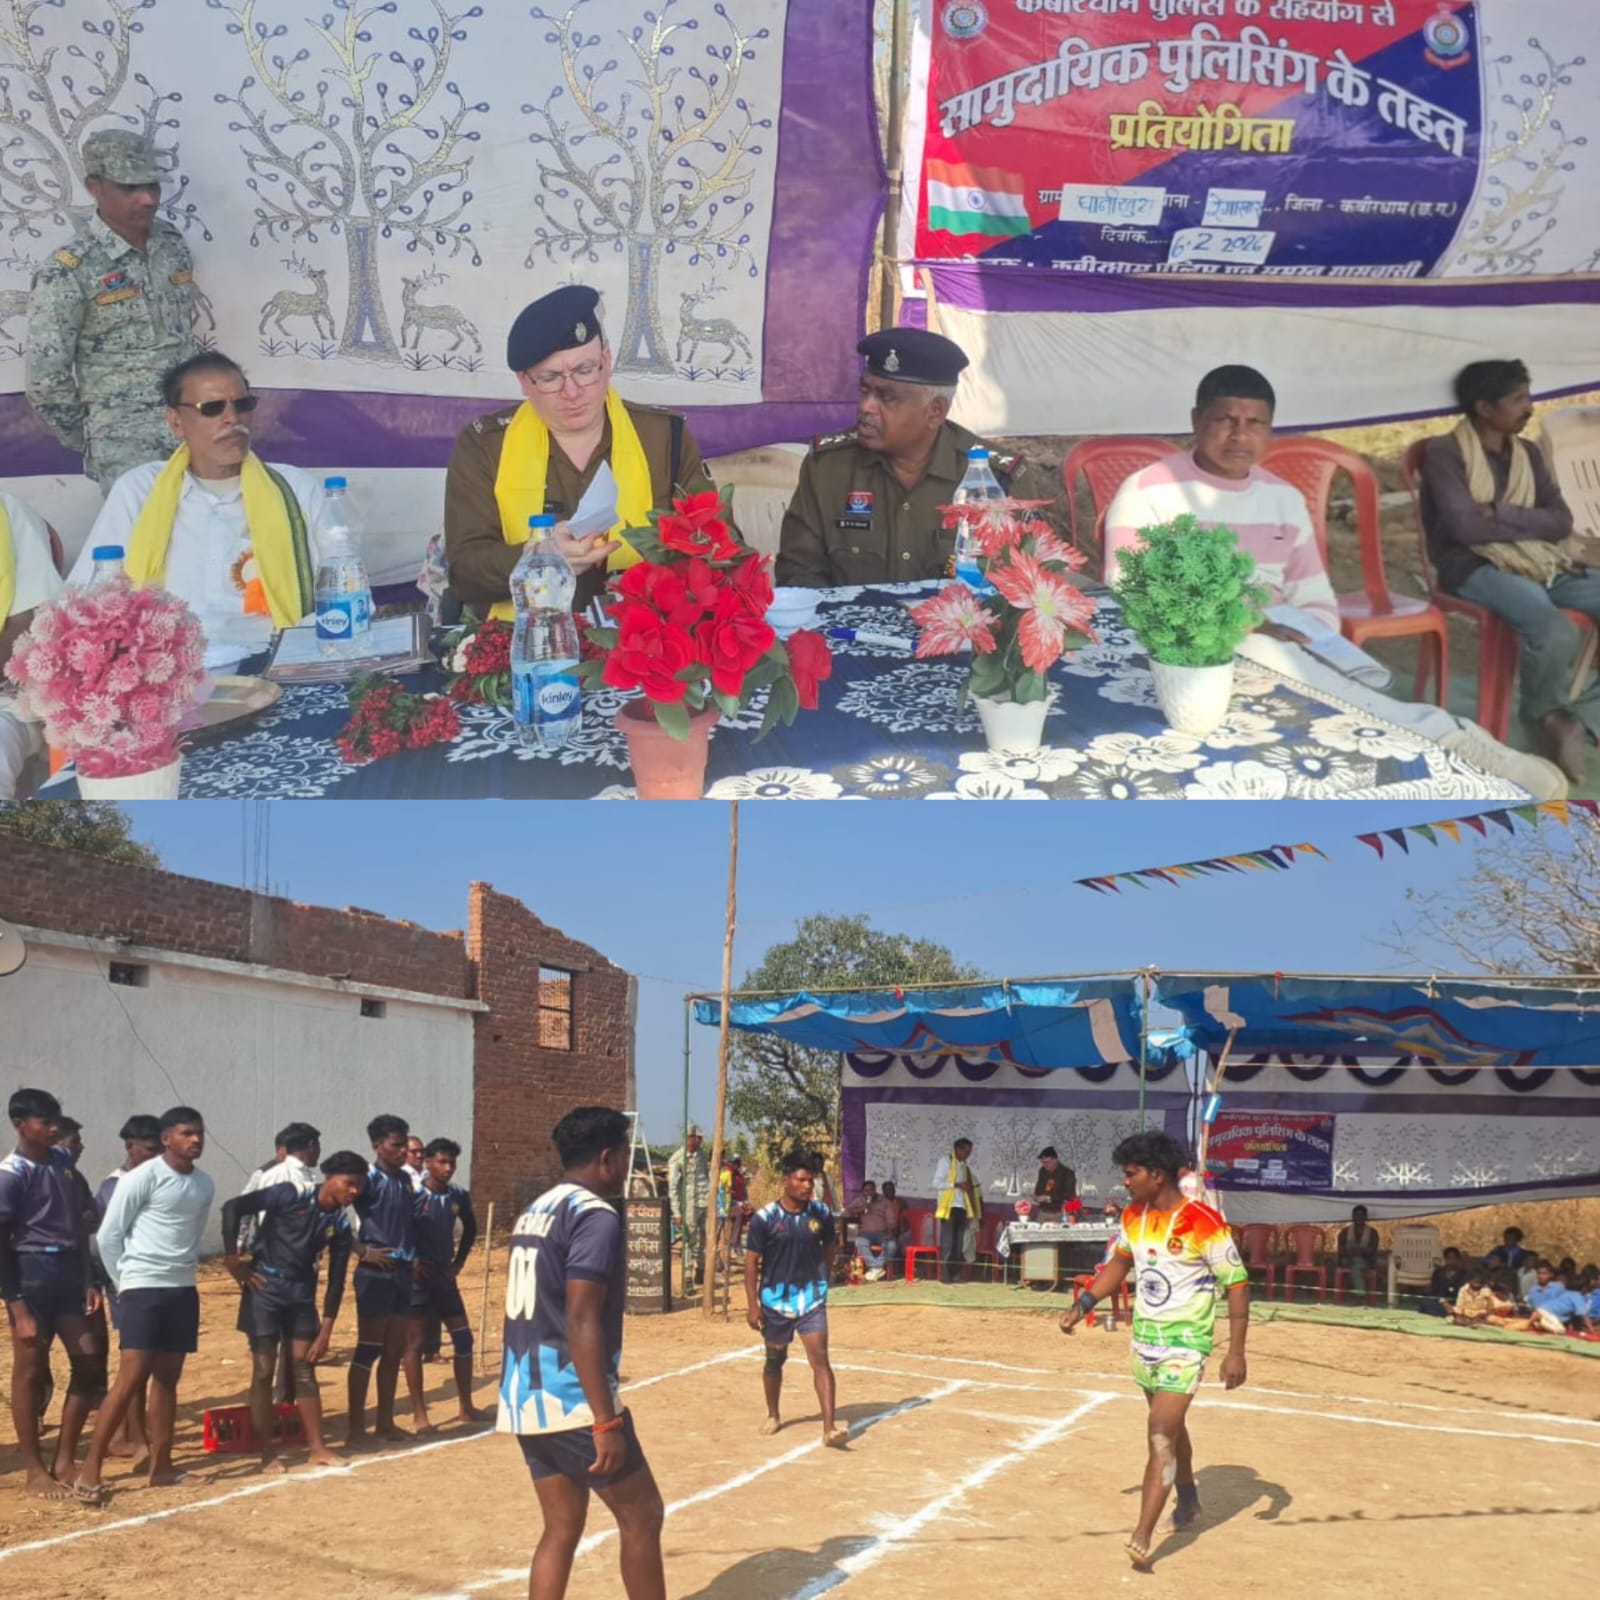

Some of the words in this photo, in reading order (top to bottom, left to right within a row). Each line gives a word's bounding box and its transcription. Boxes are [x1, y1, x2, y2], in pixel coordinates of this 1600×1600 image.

[939, 36, 1152, 140] सामुदायिक
[1156, 23, 1319, 94] पुलिसिंग
[1326, 48, 1371, 107] के
[1376, 77, 1468, 157] तहत
[1108, 99, 1296, 153] प्रतियोगिता
